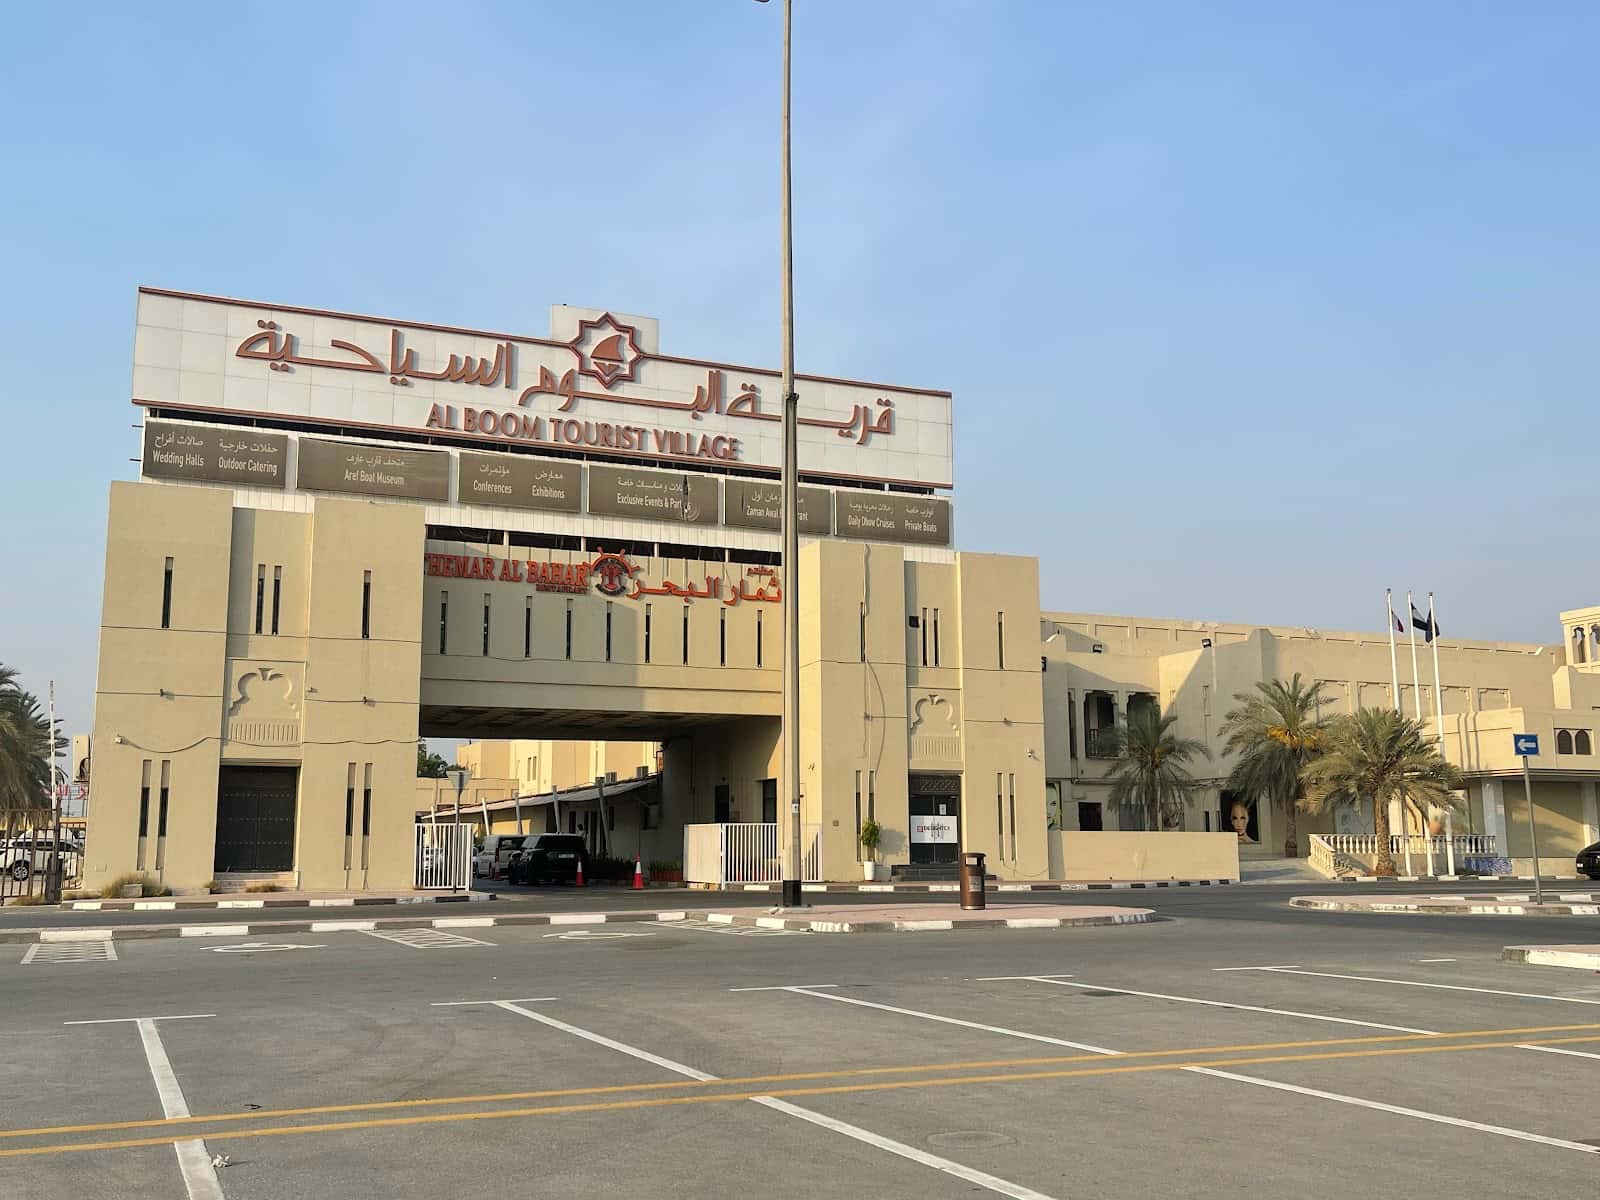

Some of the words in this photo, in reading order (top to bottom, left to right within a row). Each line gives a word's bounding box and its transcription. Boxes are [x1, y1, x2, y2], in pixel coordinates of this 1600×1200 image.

[236, 319, 513, 389] السياحية
[518, 365, 722, 419] البوم
[726, 383, 891, 445] قرية
[426, 402, 456, 430] AL
[463, 406, 541, 440] BOOM
[549, 417, 646, 451] TOURIST
[653, 428, 739, 461] VILLAGE
[177, 434, 204, 446] صالات
[219, 438, 247, 453] خارجية
[250, 442, 278, 453] حفلات
[152, 449, 184, 468] Wedding
[185, 452, 205, 467] Halls
[218, 456, 247, 471] Outdoor
[247, 459, 278, 477] Catering
[360, 470, 376, 483] Boat
[376, 471, 405, 486] Museum
[473, 479, 513, 494] Conferences
[531, 484, 565, 499] Exhibitions
[616, 492, 644, 507] Exclusive
[644, 495, 664, 508] Events
[664, 498, 669, 509] &
[746, 504, 765, 517] Zaman
[848, 514, 861, 529] Daily
[876, 517, 896, 529] Cruises
[904, 519, 922, 532] Private
[922, 521, 937, 533] Boats
[501, 559, 522, 583] AL
[526, 560, 590, 587] BAHAR
[627, 576, 719, 603] البحر
